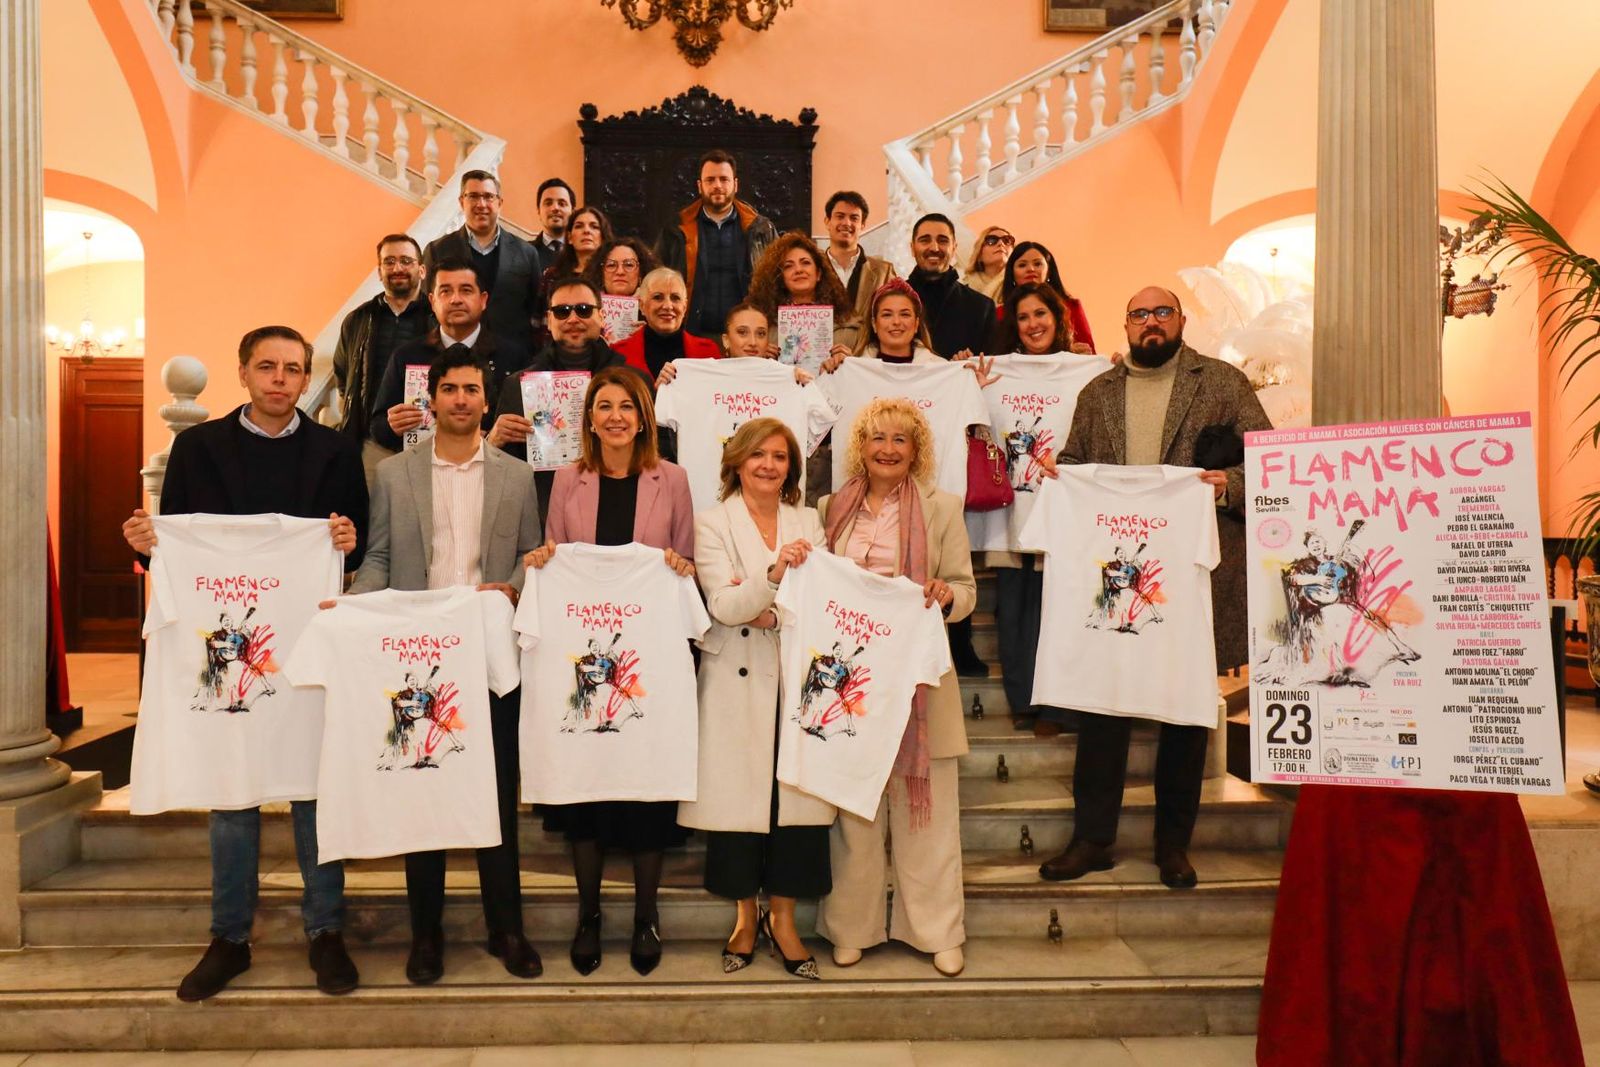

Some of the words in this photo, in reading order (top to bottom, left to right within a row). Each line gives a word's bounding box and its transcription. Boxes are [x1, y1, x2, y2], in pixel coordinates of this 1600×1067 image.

[781, 310, 830, 320] FLAMENCO
[714, 393, 777, 406] FLAMENCO
[1002, 394, 1060, 405] FLAMENCO
[728, 405, 760, 418] MAMA
[1013, 405, 1044, 417] MAMA
[1260, 433, 1296, 443] BENEFICIO
[1310, 430, 1336, 440] AMAMA
[1343, 426, 1387, 438] ASOCIACIÓN
[1389, 424, 1424, 434] MUJERES
[1426, 422, 1441, 431] CON
[1443, 419, 1475, 430] CÁNCER
[1477, 419, 1488, 428] DE
[1490, 416, 1515, 427] MAMA
[407, 433, 418, 443] 23
[1260, 438, 1513, 490] FLAMENCO
[1450, 487, 1477, 495] AURORA
[1479, 485, 1506, 493] VARGAS
[1254, 495, 1290, 506] fibes
[1461, 494, 1495, 504] ARCÁNGEL
[1308, 487, 1440, 532] MAMA
[1458, 504, 1500, 512] TREMENDITA
[1097, 514, 1167, 529] FLAMENCO
[1472, 513, 1504, 521] VALENCIA
[1447, 523, 1468, 532] PEDRO
[1470, 523, 1478, 531] EL
[1479, 520, 1515, 531] GRANAÍNO
[1110, 527, 1148, 543] MAMA
[1436, 533, 1457, 541] ALICIA
[1451, 542, 1476, 550] RAFAEL
[1477, 541, 1486, 550] DE
[1487, 540, 1513, 549] UTRERA
[1459, 550, 1480, 558] DAVID
[1481, 549, 1507, 558] CARPIO
[1437, 566, 1457, 575] DAVID
[1508, 564, 1531, 572] RIVERA
[196, 575, 279, 591] FLAMENCO
[1454, 585, 1484, 594] AMPARO
[1486, 584, 1516, 592] LAGARES
[214, 590, 258, 607] MAMA
[1432, 594, 1449, 602] DANI
[1517, 592, 1541, 600] TOVAR
[567, 603, 642, 617] FLAMENCO
[1440, 604, 1457, 612] FRAN
[1459, 602, 1484, 612] CORTÉS
[826, 600, 891, 637] FLAMENCO
[583, 617, 623, 633] MAMA
[1436, 622, 1456, 630] SILVIA
[1517, 619, 1542, 629] CORTÉS
[835, 619, 871, 644] MAMA
[382, 635, 460, 651] FLAMENCO
[1457, 639, 1487, 647] PATRICIA
[1488, 639, 1521, 647] GUERRERO
[399, 650, 441, 666] MAMA
[1462, 658, 1491, 666] PASTORA
[1445, 668, 1473, 676] ANTONIO
[1474, 668, 1500, 676] MOLINA
[1393, 679, 1406, 687] EVA
[1407, 679, 1422, 687] RUIZ
[1470, 678, 1495, 686] AMAYA
[1266, 690, 1310, 701] DOMINGO
[1487, 696, 1519, 704] REQUENA
[1442, 705, 1472, 713] ANTONIO
[1266, 703, 1312, 745] 23
[1470, 716, 1484, 724] LITO
[1486, 716, 1521, 724] ESPINOSA
[1401, 734, 1416, 744] AG
[1501, 737, 1524, 745] ACEDO
[1268, 748, 1311, 760] FEBRERO
[1476, 754, 1497, 765] PÉREZ
[1273, 763, 1297, 773] 17:00
[1499, 766, 1524, 775] TERUEL
[1450, 775, 1468, 783] PACO
[1470, 775, 1488, 784] VEGA
[1490, 776, 1495, 784] Y
[1496, 774, 1520, 786] RUBÉN
[1522, 777, 1551, 787] VARGAS
